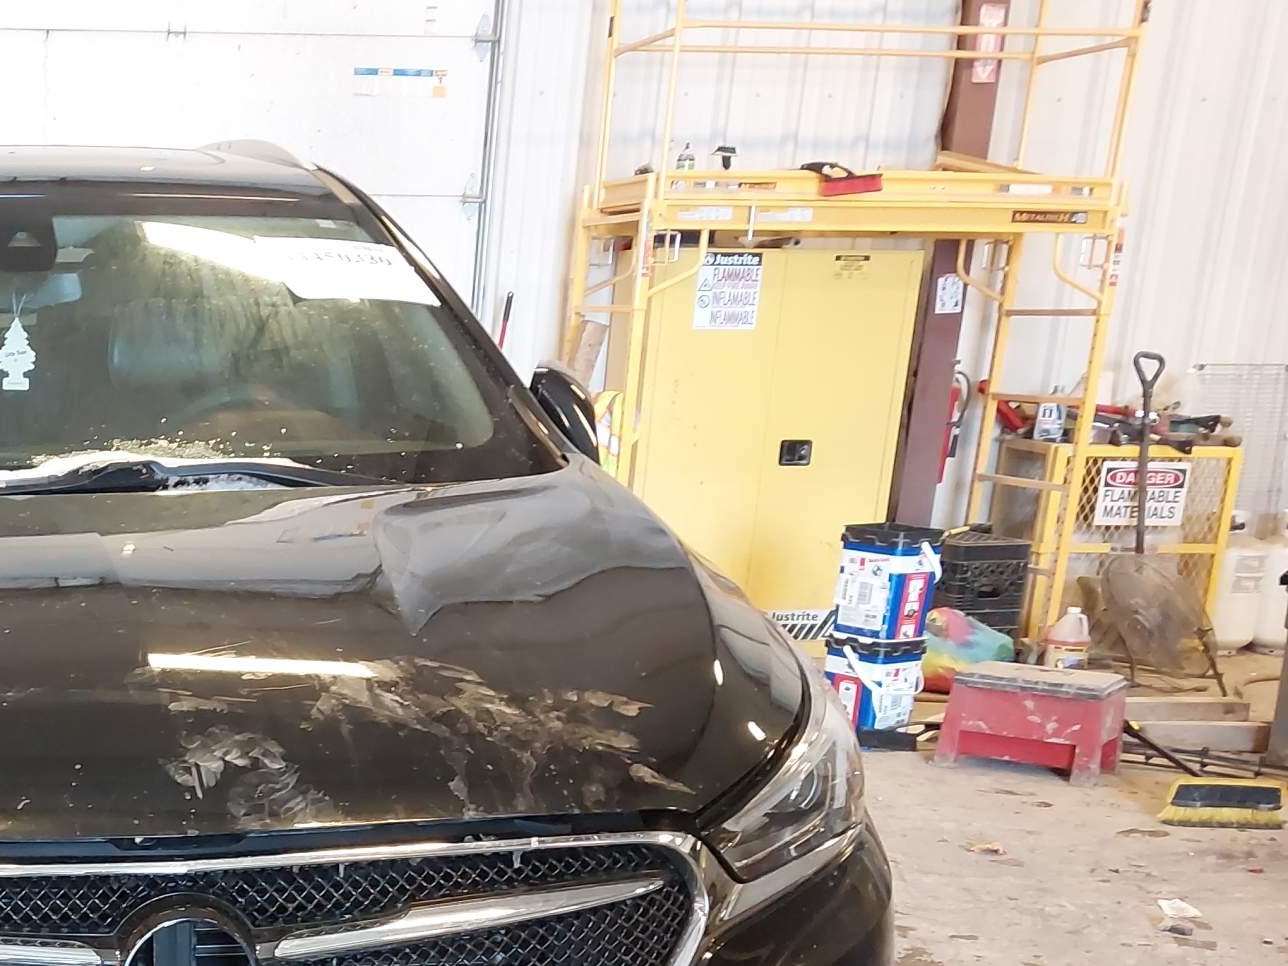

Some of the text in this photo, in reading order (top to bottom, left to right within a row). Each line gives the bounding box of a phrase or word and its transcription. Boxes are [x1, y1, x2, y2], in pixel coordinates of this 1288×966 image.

[715, 254, 761, 265] Justrite
[713, 267, 761, 282] FLAMMABLE
[1115, 472, 1176, 485] DAGER
[1103, 489, 1182, 503] FLAMABLE
[1102, 505, 1176, 519] MATEIALS
